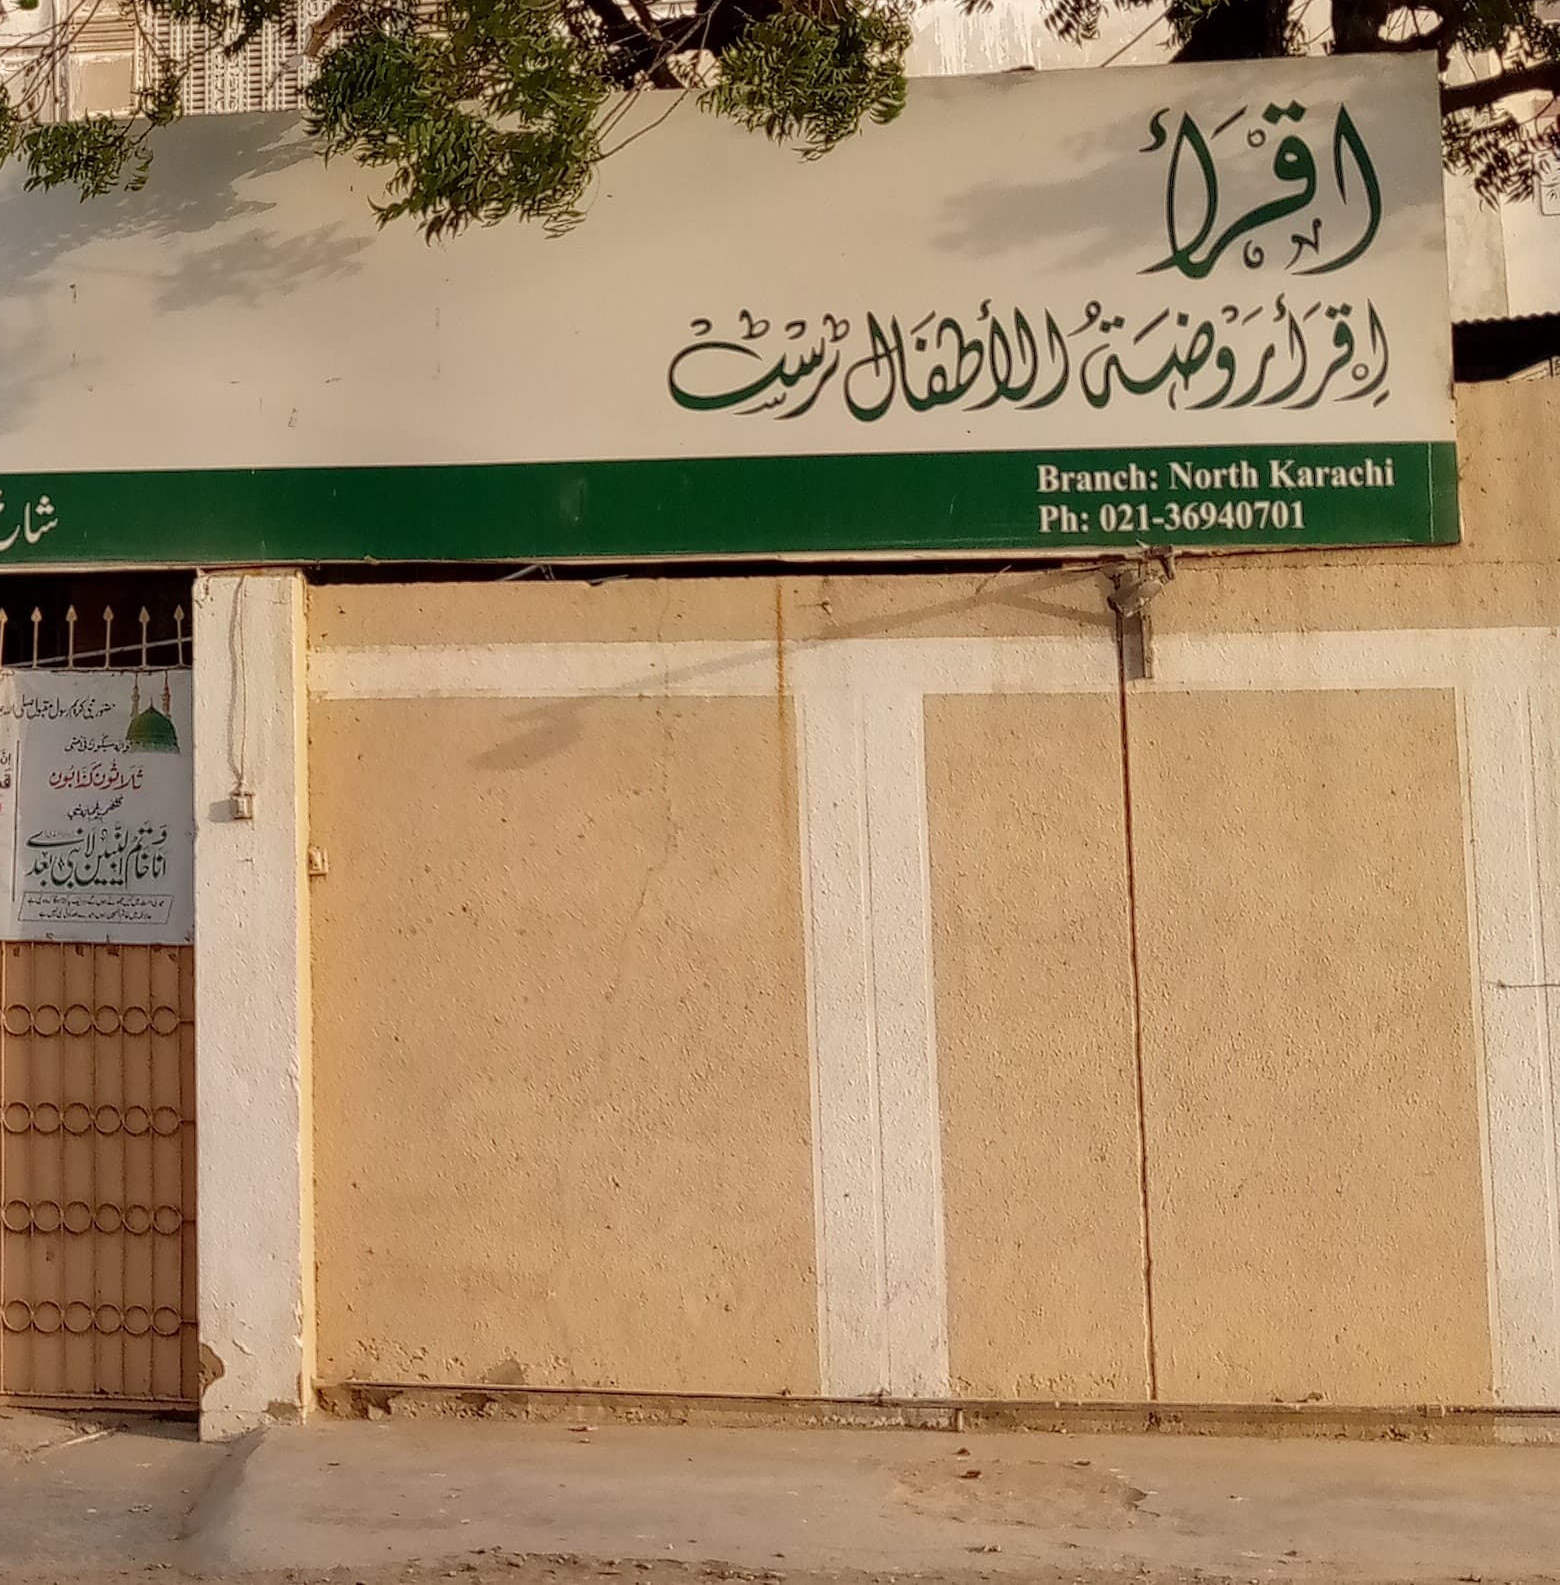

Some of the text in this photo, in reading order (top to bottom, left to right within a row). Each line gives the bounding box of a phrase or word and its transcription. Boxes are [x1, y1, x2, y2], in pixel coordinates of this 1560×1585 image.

[1037, 457, 1395, 493] Branch: North Karachi
[1038, 500, 1306, 534] Ph: 021-36940701
